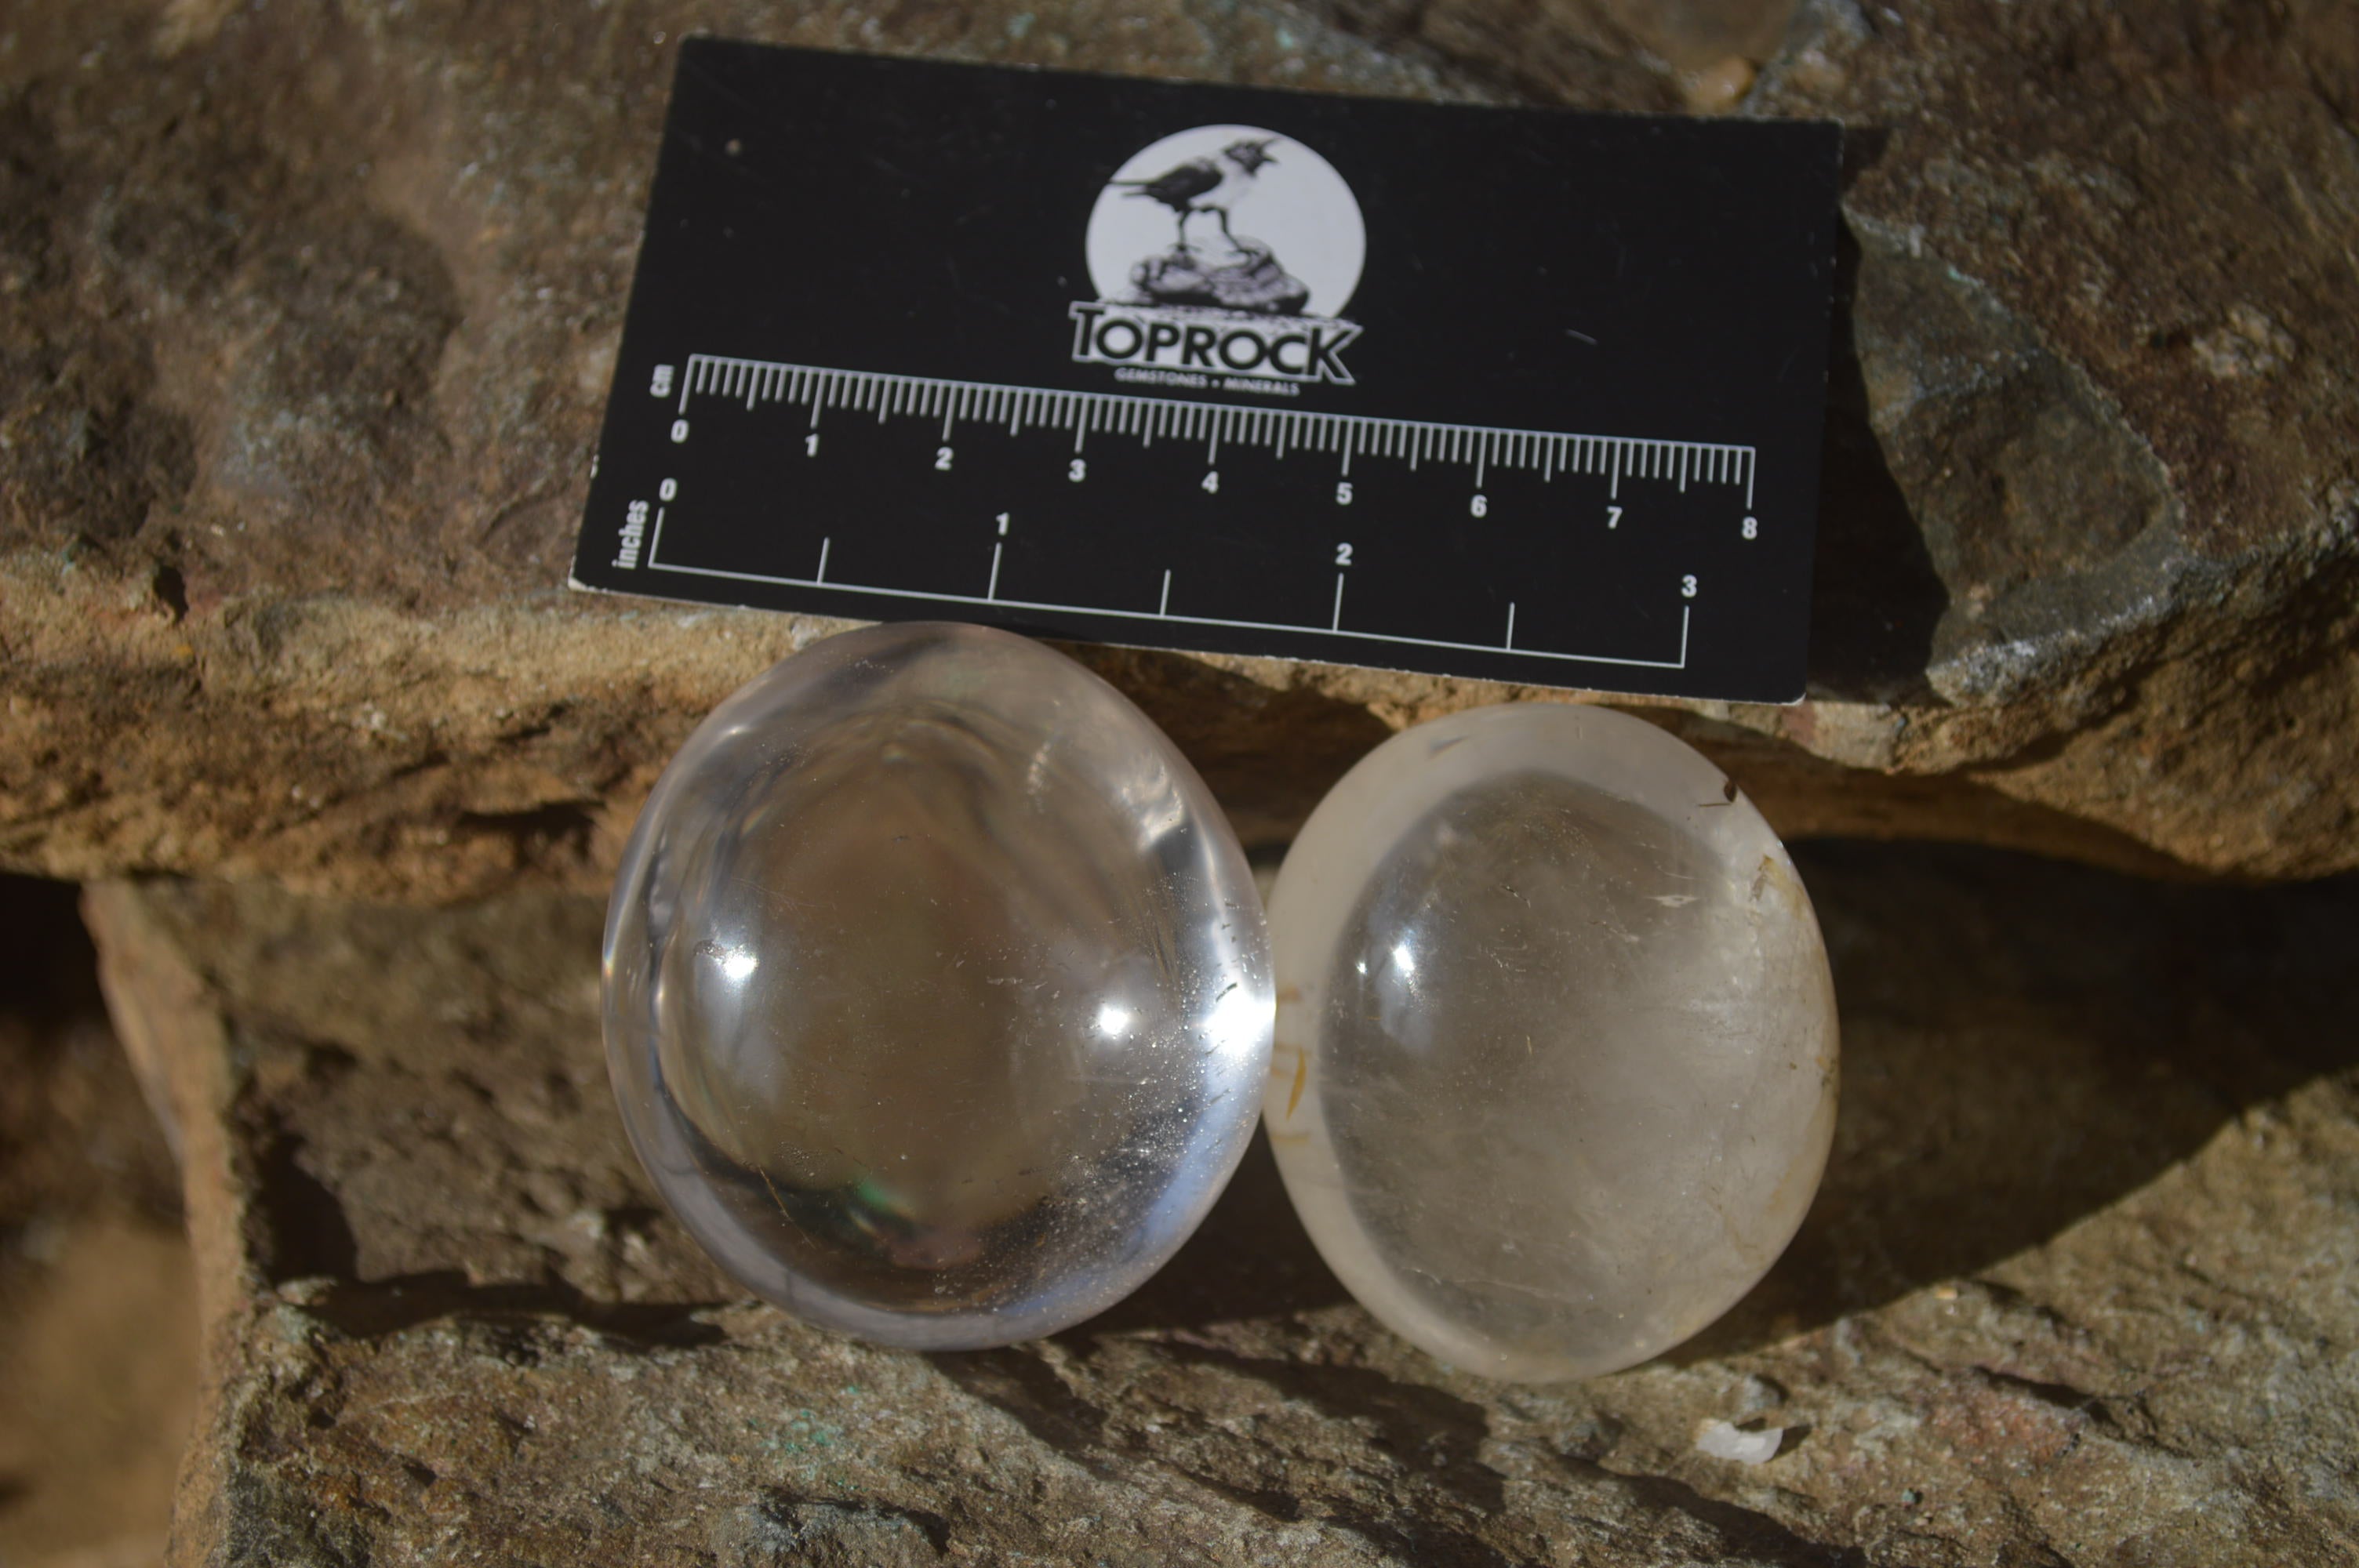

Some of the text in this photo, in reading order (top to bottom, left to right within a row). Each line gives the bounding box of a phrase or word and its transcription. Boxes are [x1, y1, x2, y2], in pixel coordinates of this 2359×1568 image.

[649, 364, 674, 397] cm
[1068, 301, 1364, 387] TOPROCK
[1114, 367, 1301, 397] GEMSTONES MINERALS
[671, 419, 1757, 540] 0 1 2 3 4 5 6 7 8
[611, 499, 649, 570] inches
[659, 477, 1697, 598] 0 1 2 3
